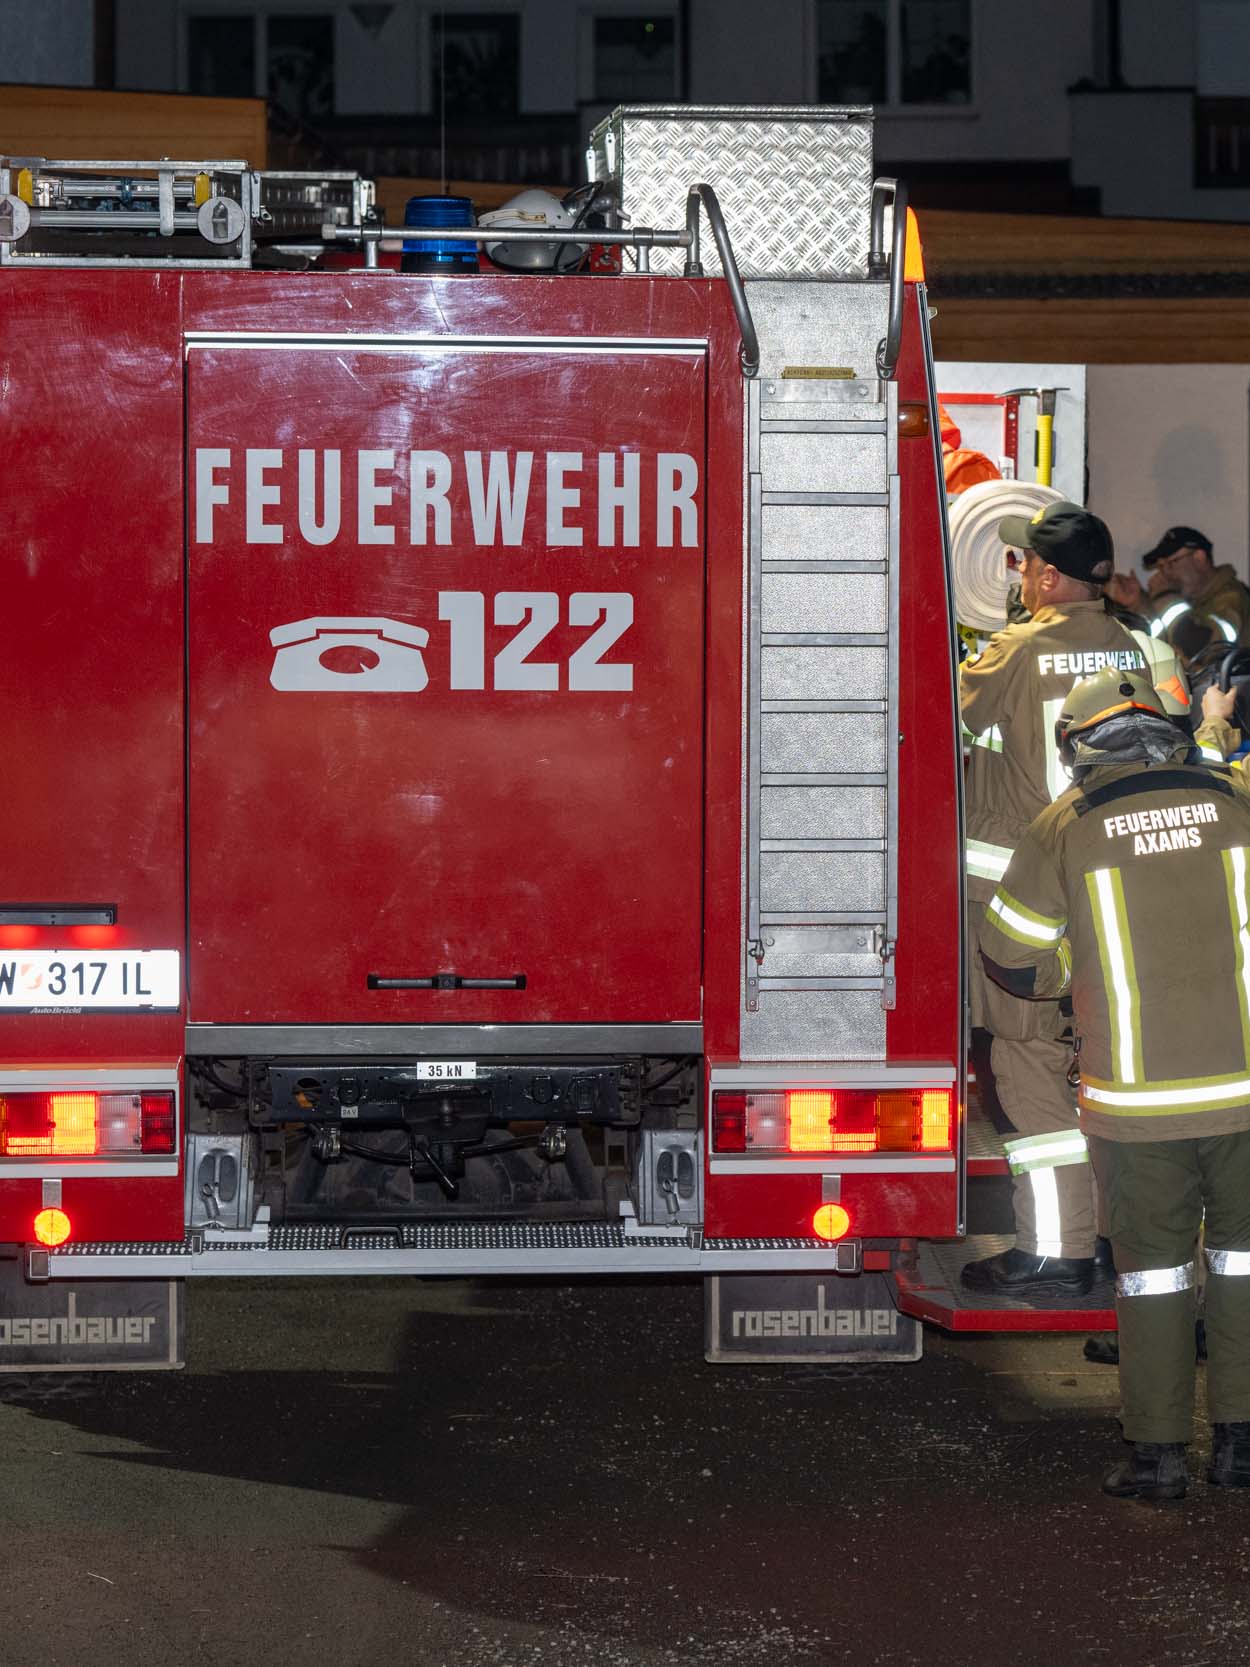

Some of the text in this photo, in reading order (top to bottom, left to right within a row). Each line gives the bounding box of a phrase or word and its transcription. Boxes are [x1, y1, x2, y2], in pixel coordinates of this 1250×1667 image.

[195, 447, 699, 547] FEUERWEHR
[438, 591, 634, 691] 122
[1038, 650, 1146, 676] FEUERWEHR
[1103, 803, 1219, 839] FEUERWEHR
[1134, 827, 1202, 856] AXAMS
[48, 962, 107, 995] 317
[122, 962, 152, 995] IL
[428, 1065, 462, 1077] 35 kN
[733, 1285, 900, 1336] rosenbauer
